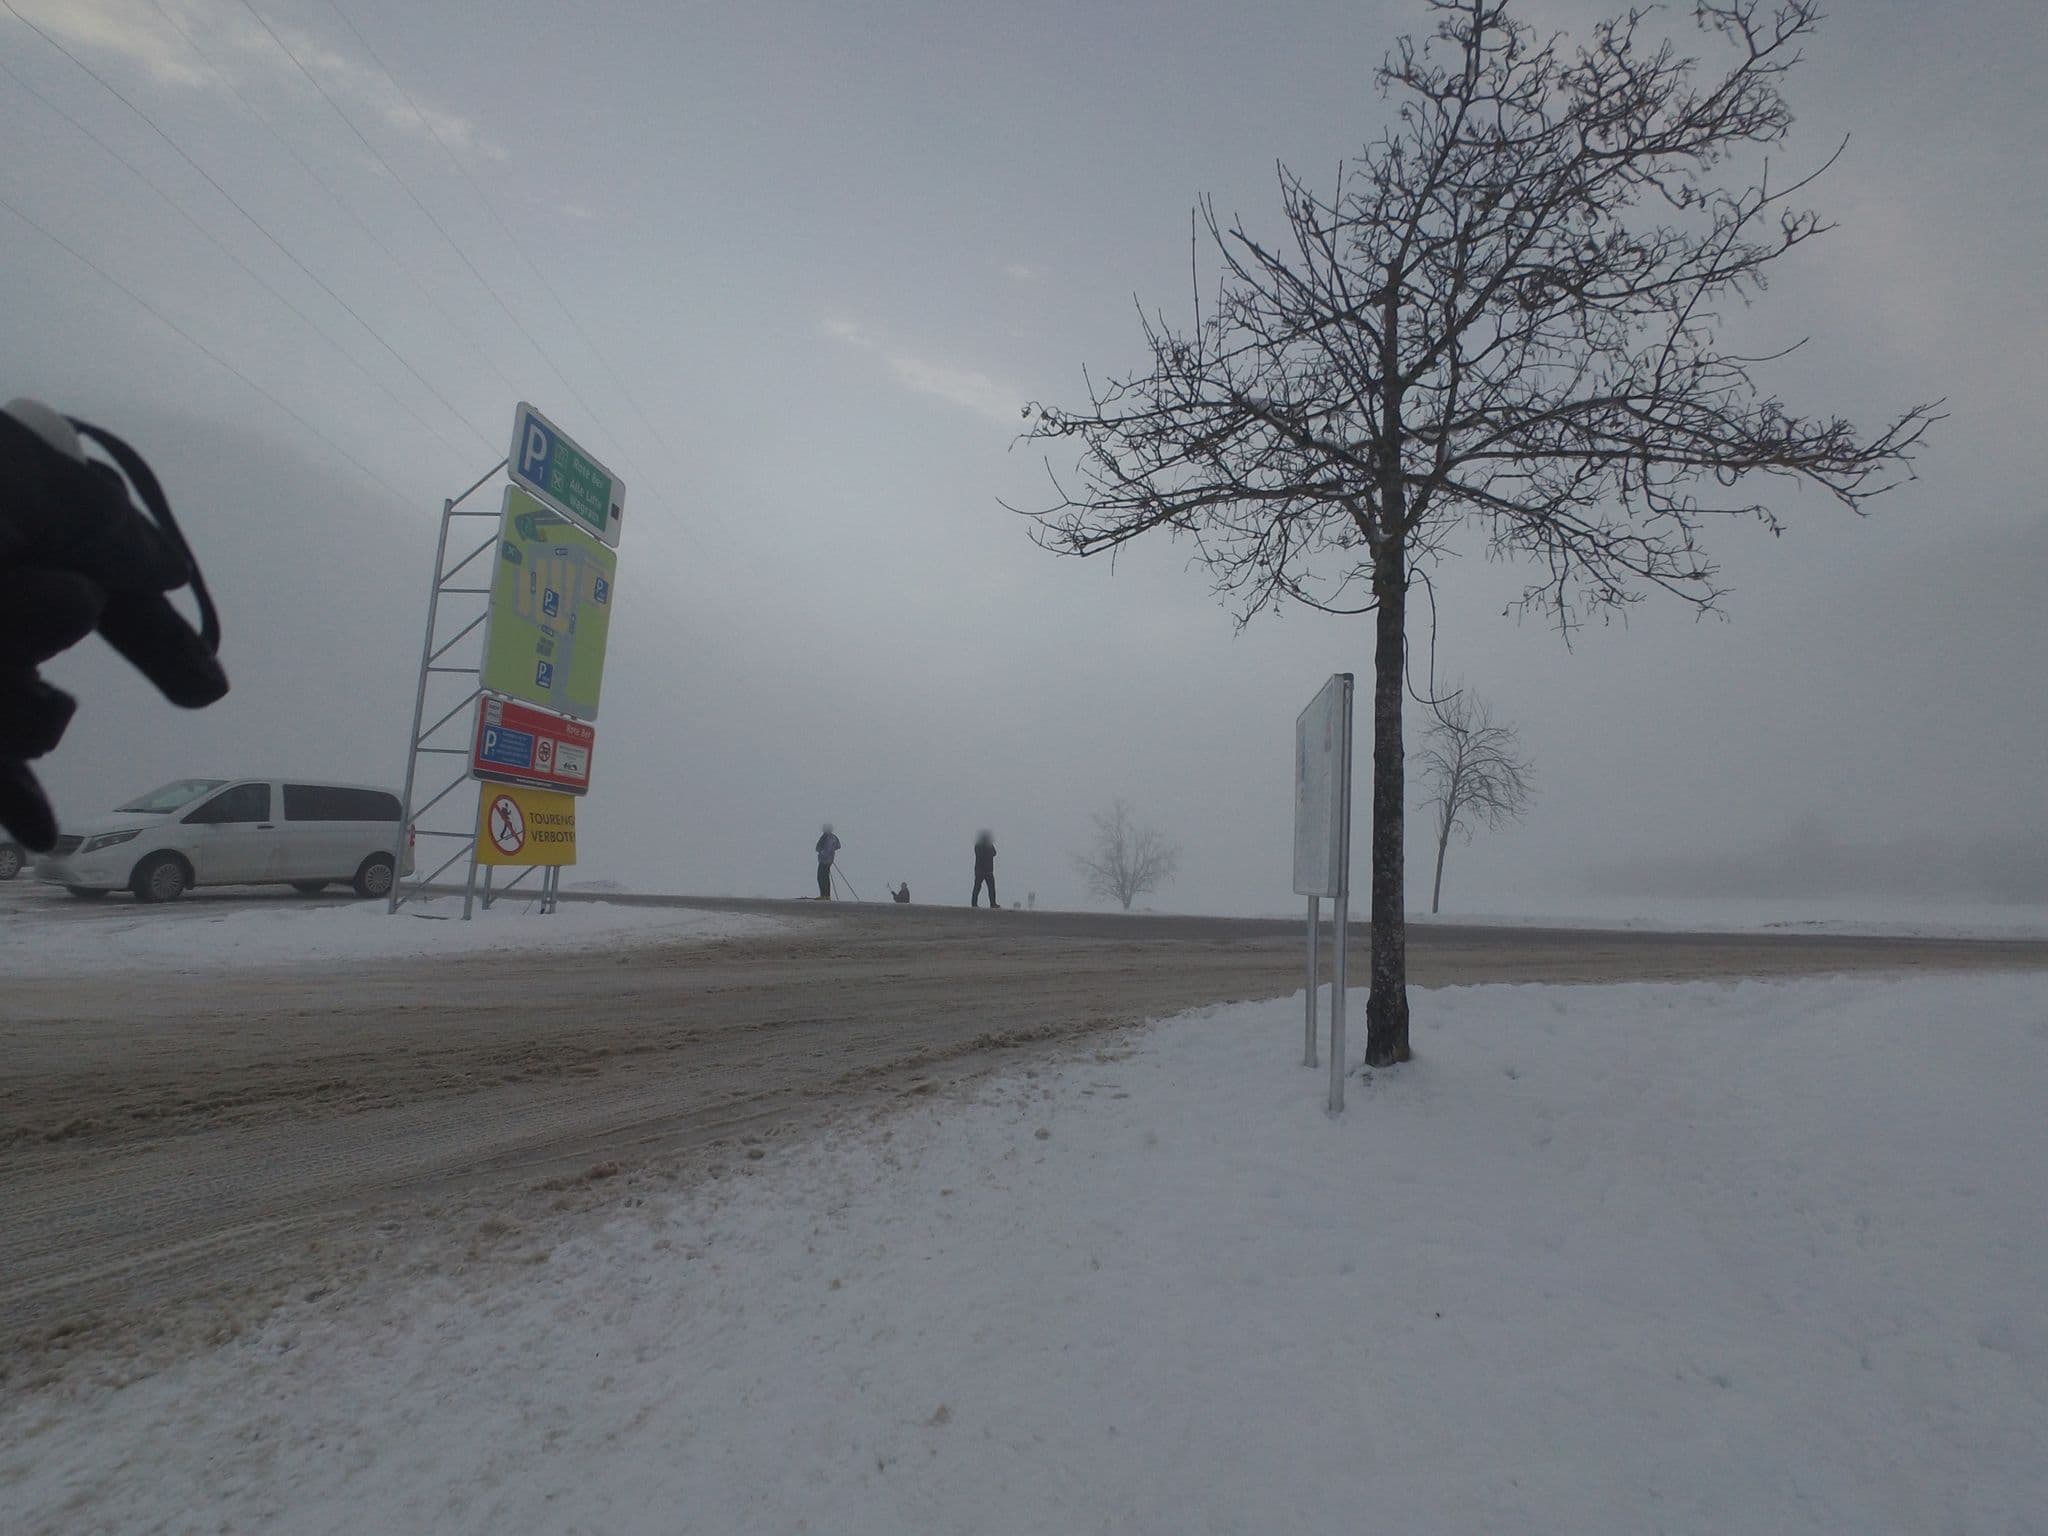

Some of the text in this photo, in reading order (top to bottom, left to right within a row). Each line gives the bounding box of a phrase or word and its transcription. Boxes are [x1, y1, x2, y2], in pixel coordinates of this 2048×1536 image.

[524, 424, 547, 472] P
[544, 590, 553, 607] P
[538, 662, 547, 680] P
[485, 730, 497, 755] P
[529, 812, 576, 825] TOURENG
[532, 831, 576, 842] VERBOTE
